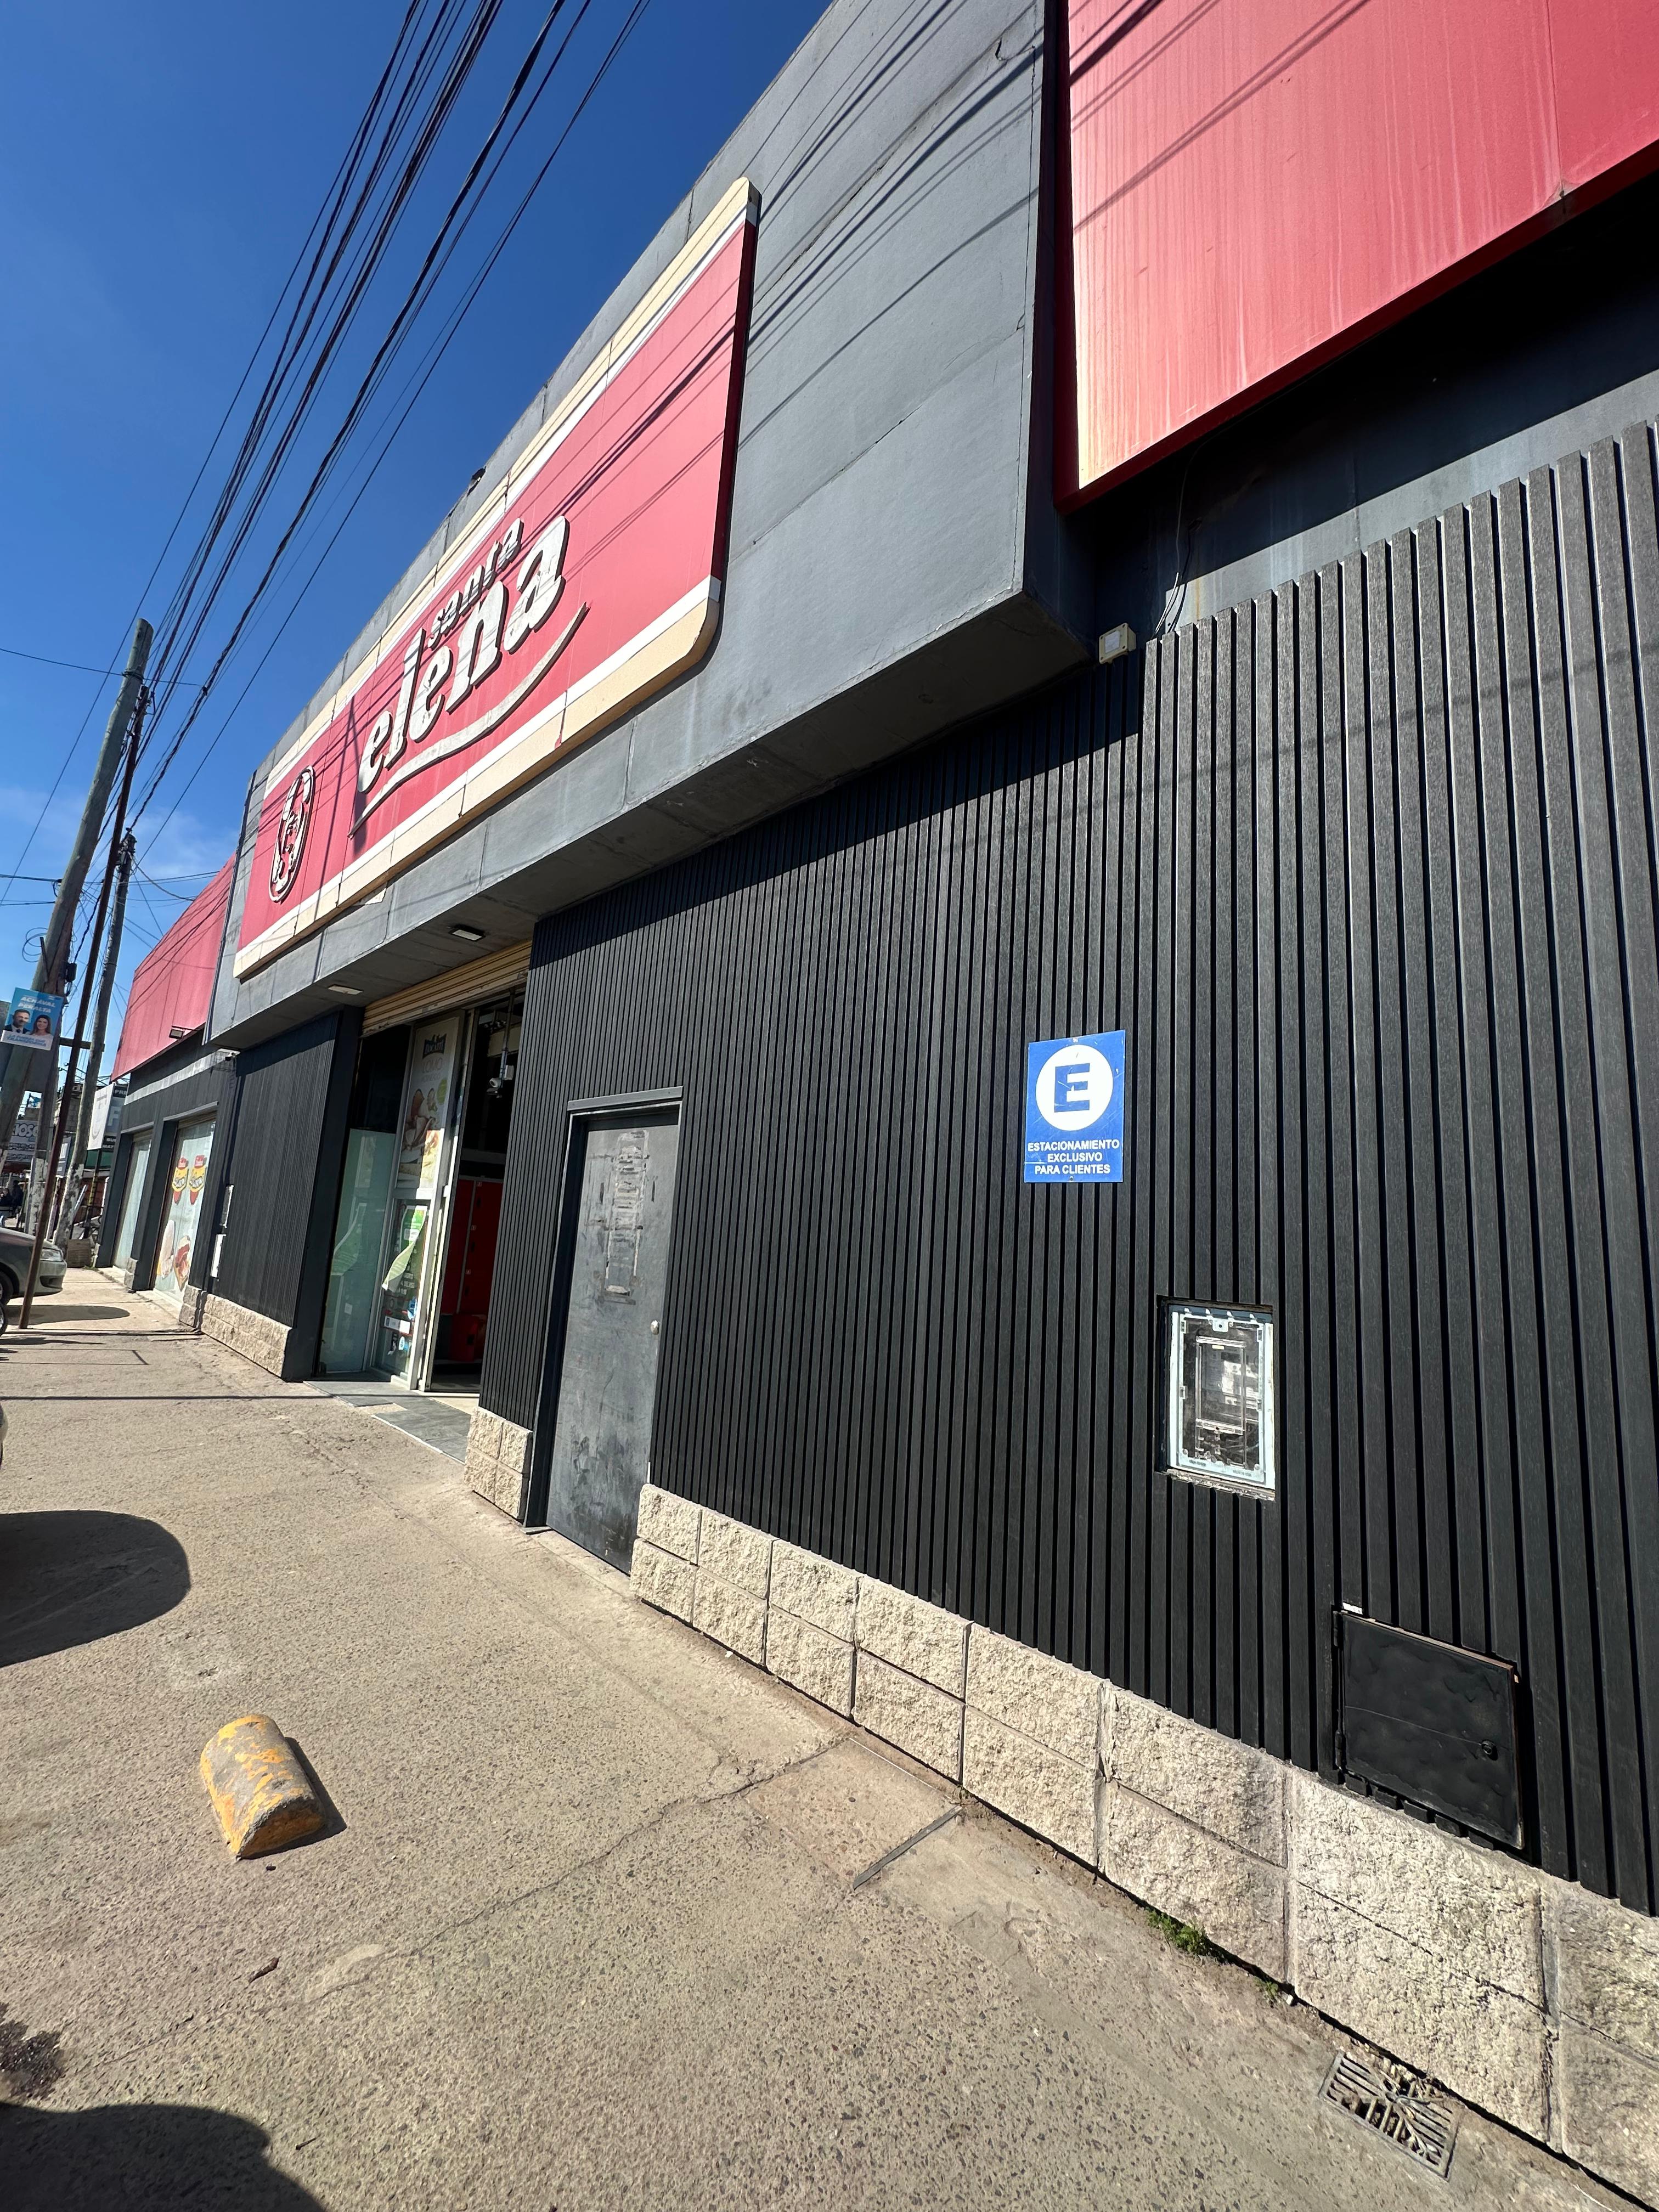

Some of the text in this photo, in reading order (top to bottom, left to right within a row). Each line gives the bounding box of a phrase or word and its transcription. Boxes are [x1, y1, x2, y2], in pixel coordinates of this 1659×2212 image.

[428, 517, 524, 651] santa
[357, 515, 569, 794] elena
[1053, 1063, 1091, 1113] E
[1027, 1139, 1120, 1152] ESTACIONAMIENTO
[1047, 1152, 1103, 1163] EXCLUSIVO
[1035, 1164, 1110, 1175] PARA CLIENTES
